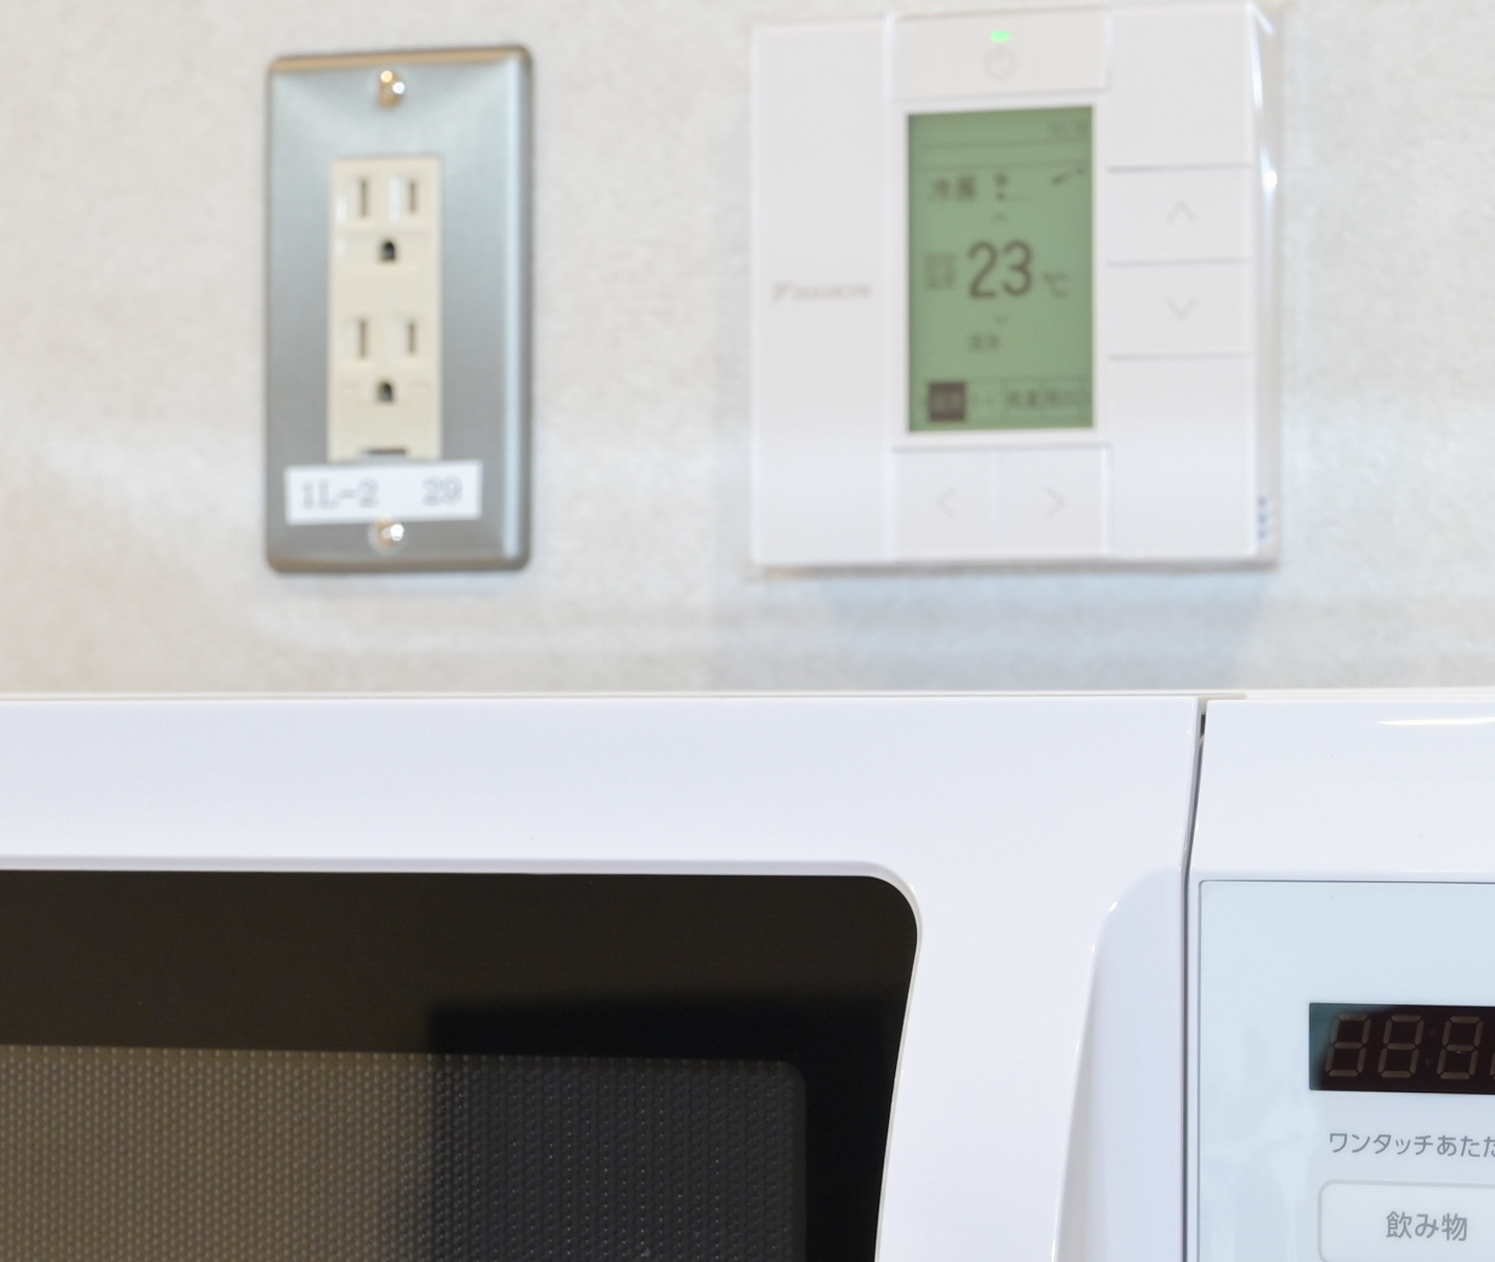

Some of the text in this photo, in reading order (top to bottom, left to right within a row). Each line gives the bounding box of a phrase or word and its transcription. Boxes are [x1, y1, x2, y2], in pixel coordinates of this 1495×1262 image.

[967, 239, 1035, 300] 23
[421, 475, 464, 507] 29
[1385, 1210, 1469, 1243] 飲み物
